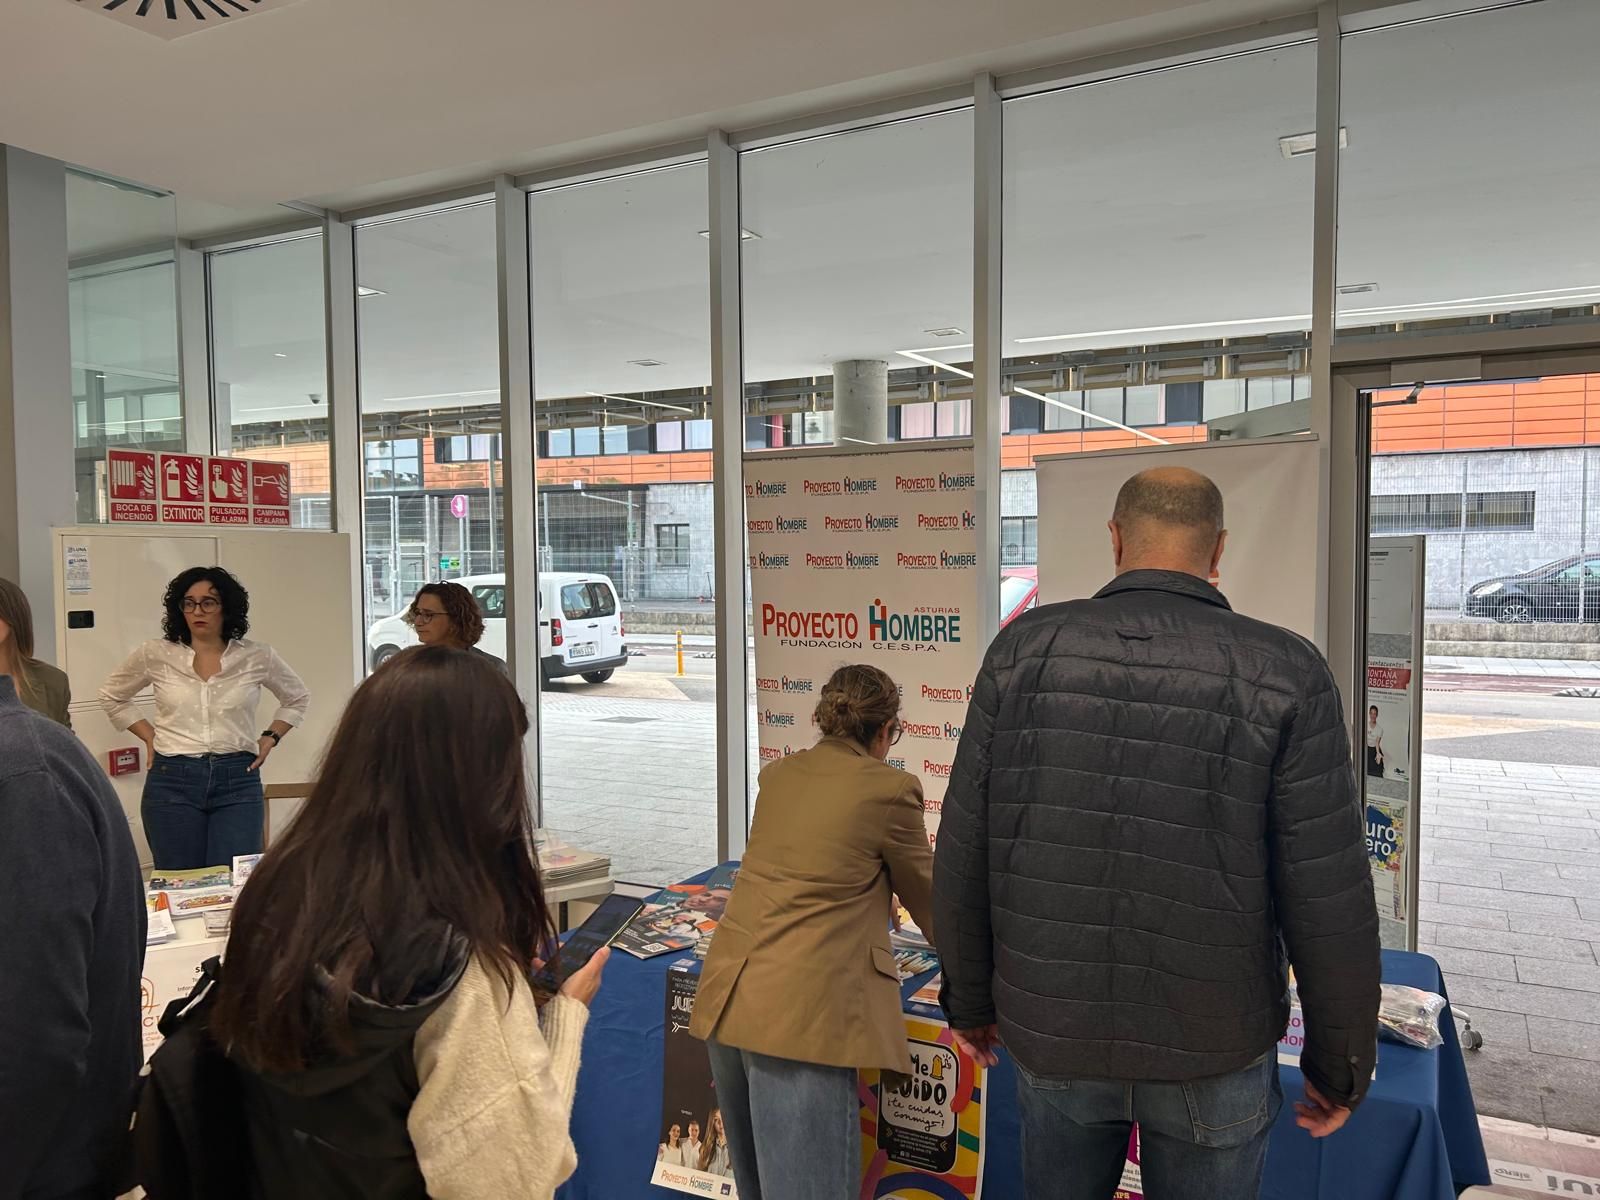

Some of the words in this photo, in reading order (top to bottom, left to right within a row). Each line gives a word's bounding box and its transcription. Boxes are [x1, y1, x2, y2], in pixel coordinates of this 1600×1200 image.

[756, 480, 786, 495] HOMBRE
[803, 480, 840, 493] PROYECTO
[843, 476, 877, 492] HOMBRE
[896, 476, 935, 490] PROYECTO
[939, 472, 975, 489] HOMBRE
[116, 504, 140, 512] BOCA
[141, 504, 152, 512] DE
[163, 507, 205, 521] EXTINTOR
[211, 507, 246, 516] PULSADOR
[256, 509, 286, 517] CAMPANA
[115, 512, 154, 521] INCENDIO
[221, 515, 248, 524] ALARMA
[263, 517, 289, 525] ALARMA
[776, 516, 807, 531] HOMBRE
[825, 517, 862, 530] PROYECTO
[865, 513, 898, 530] HOMBRE
[918, 515, 958, 528] PROYECTO
[759, 552, 789, 567] HOMBRE
[806, 553, 842, 566] PROYECTO
[846, 551, 879, 566] HOMBRE
[898, 553, 937, 566] PROYECTO
[940, 550, 976, 567] HOMBRE
[762, 603, 859, 640] PROYECTO
[869, 598, 961, 643] HOMBRE
[780, 639, 863, 649] FUNDACIÓN
[872, 642, 941, 652] C.E.S.P.A.
[782, 675, 813, 691] HOMBRE
[921, 685, 962, 700] PROYECTO
[765, 709, 794, 725] HOMBRE
[902, 720, 940, 737] PROYECTO
[924, 760, 952, 775] PROYEC
[1366, 821, 1397, 842] uro
[1366, 838, 1391, 856] ero
[908, 1104, 943, 1117] cuidas
